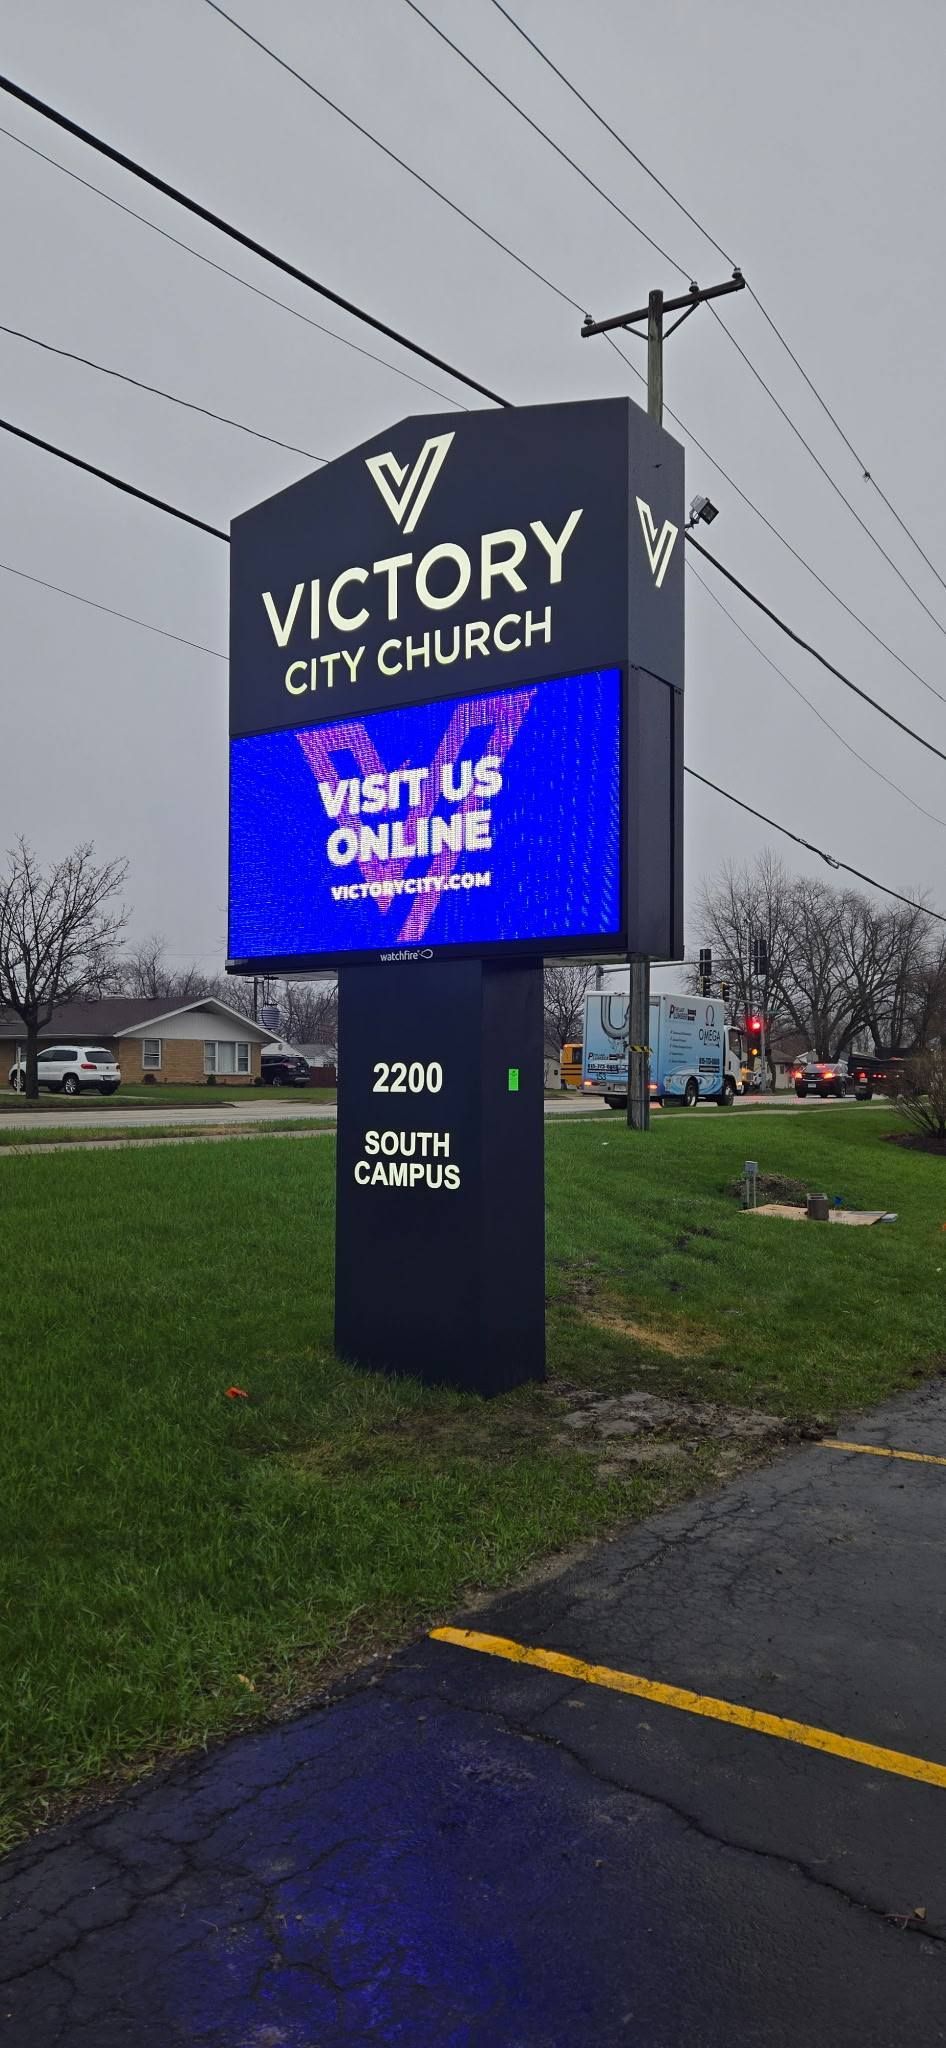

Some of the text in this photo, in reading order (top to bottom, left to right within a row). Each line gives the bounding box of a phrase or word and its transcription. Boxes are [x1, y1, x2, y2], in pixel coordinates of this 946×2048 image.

[261, 508, 584, 648] VICTORY
[284, 605, 552, 695] CITY CHURCH
[317, 754, 503, 818] VISIT US
[326, 809, 493, 867] ONLINE
[331, 871, 492, 901] VICTORYCITY.COM
[698, 1028, 721, 1042] OMEGA
[372, 1061, 444, 1094] 2200
[364, 1130, 450, 1158] SOUTH
[354, 1160, 461, 1190] CAMPUS
